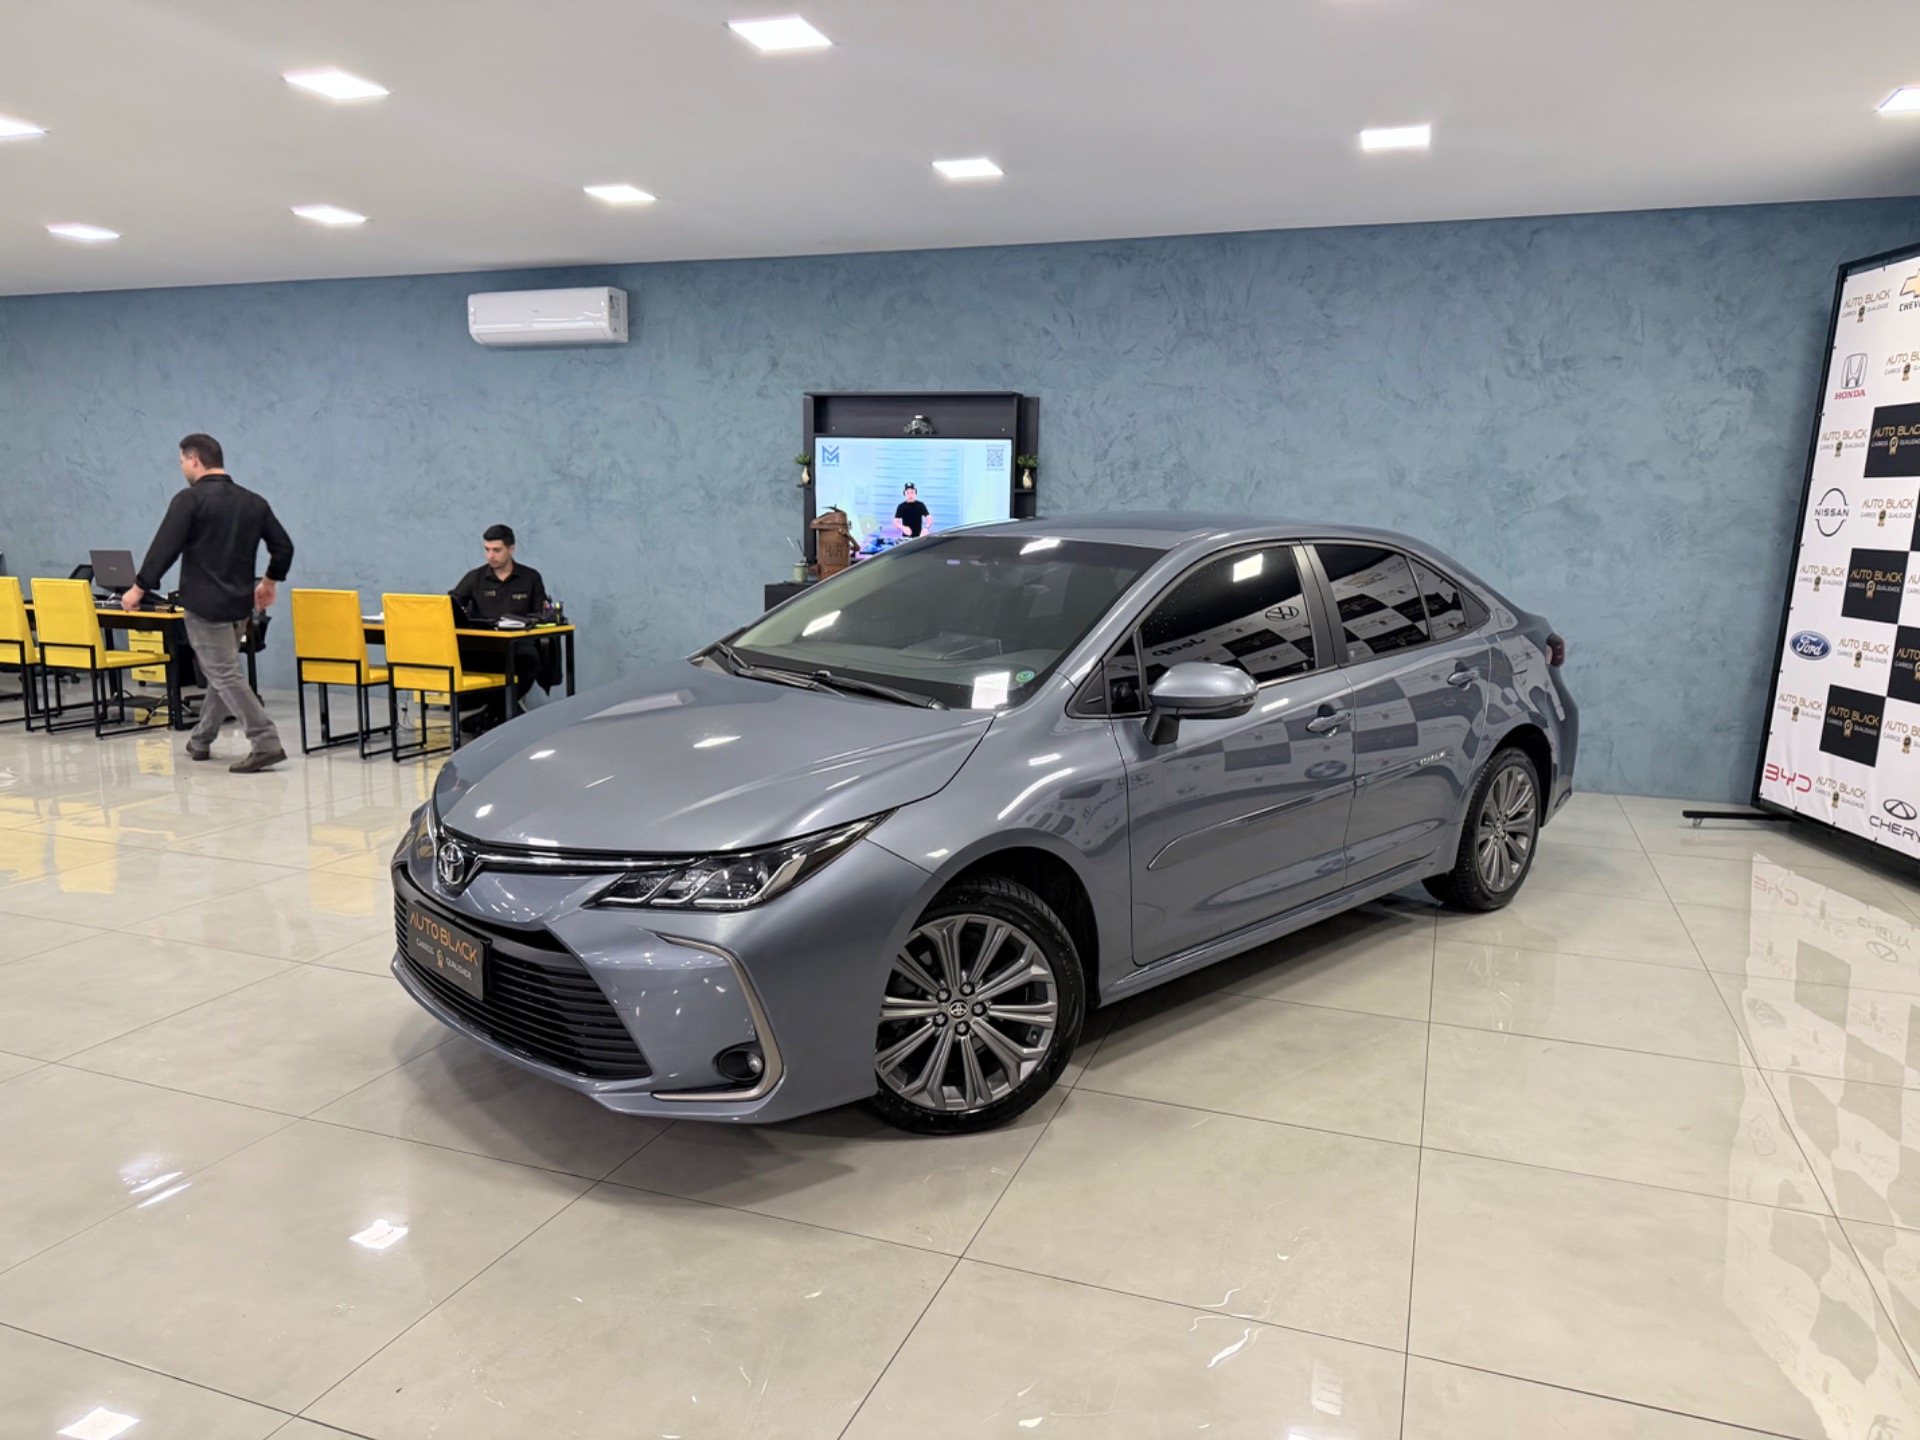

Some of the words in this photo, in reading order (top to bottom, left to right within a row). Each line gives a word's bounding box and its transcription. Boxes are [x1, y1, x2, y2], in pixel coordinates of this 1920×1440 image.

[1844, 296, 1863, 309] AUTO
[1865, 289, 1891, 304] BLACK
[1886, 353, 1908, 366] AUTO
[1834, 389, 1866, 400] HONDA
[1822, 432, 1840, 440] AUTO
[1842, 428, 1868, 439] BLACK
[1873, 426, 1895, 438] AUTO
[1862, 498, 1884, 509] AUTO
[1886, 498, 1914, 509] BLACK
[1815, 508, 1849, 517] NISSAN
[1800, 565, 1820, 574] AUTO
[1821, 566, 1845, 577] BLACK
[1850, 569, 1872, 580] AUTO
[1874, 570, 1903, 582] BLACK
[1796, 634, 1823, 656] Ford
[1838, 638, 1860, 649] AUTO
[1862, 641, 1890, 654] BLACK
[1896, 648, 1920, 660] AUTO
[1779, 693, 1797, 704] AUTO
[1800, 697, 1822, 712] BLACK
[1828, 705, 1850, 718] AUTO
[1852, 711, 1880, 726] BLACK
[1885, 720, 1908, 734] AUTO
[1765, 763, 1812, 793] BYD
[1816, 776, 1837, 790] AUTO
[1839, 782, 1866, 800] BLACK
[410, 912, 439, 940] AUTO
[440, 927, 478, 966] BLACK
